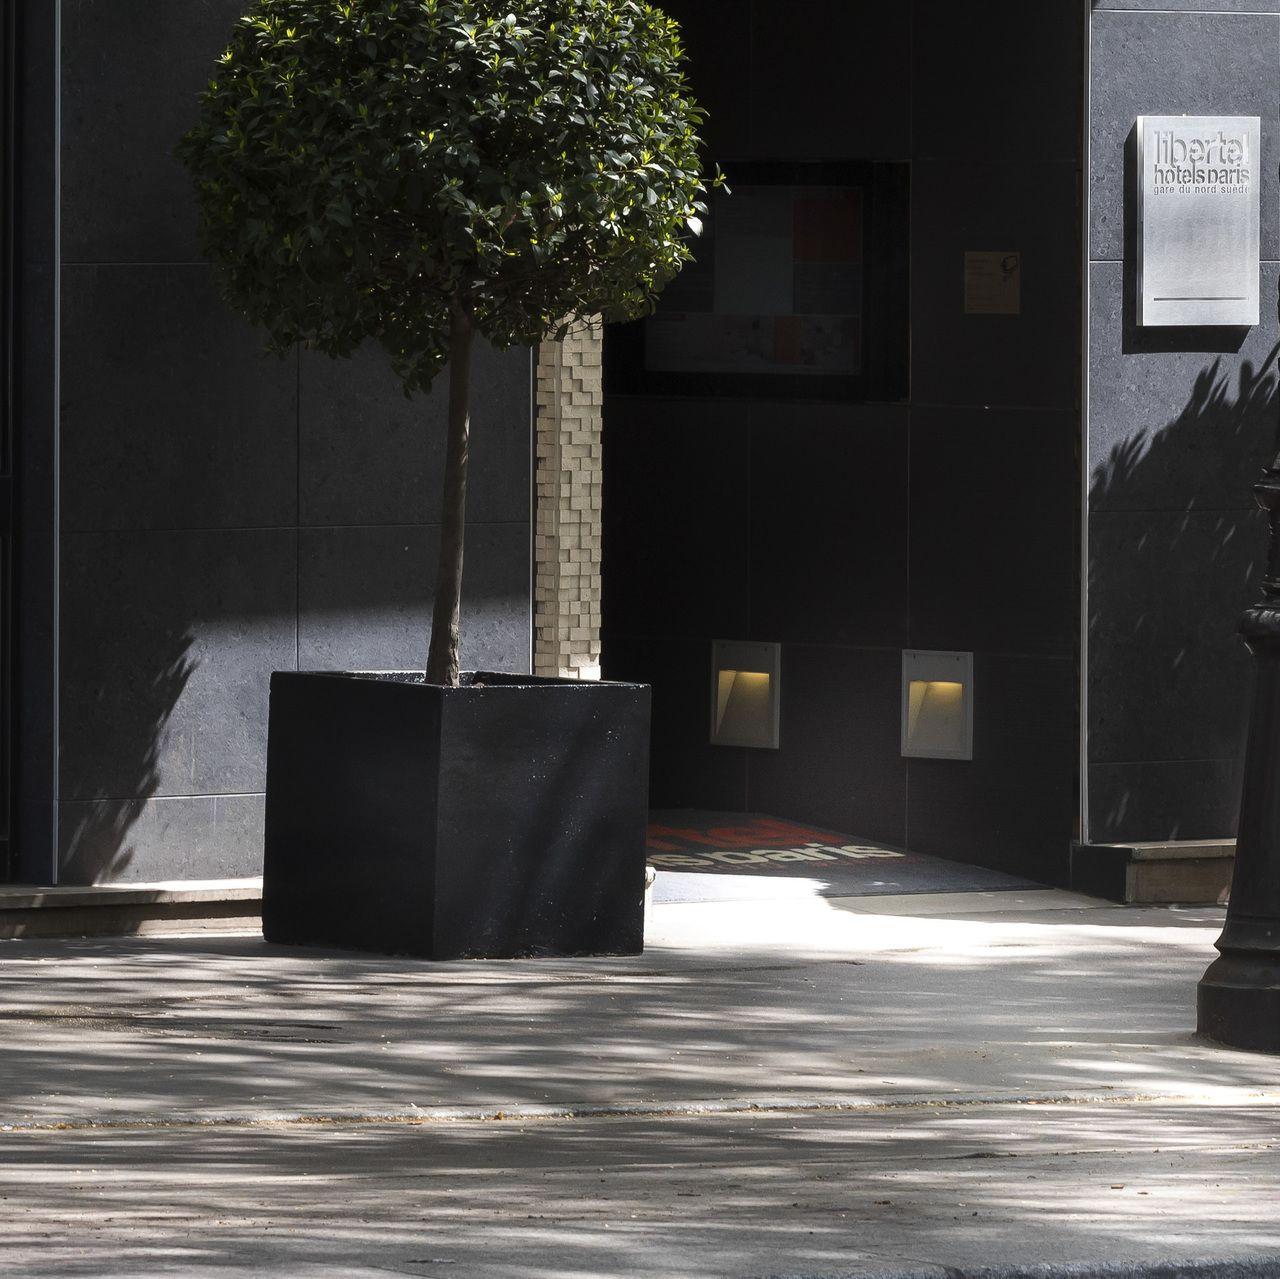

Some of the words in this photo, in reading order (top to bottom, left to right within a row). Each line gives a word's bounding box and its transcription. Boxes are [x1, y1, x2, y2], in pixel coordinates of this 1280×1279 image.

[1153, 130, 1250, 165] libertel
[1207, 163, 1250, 184] paris
[1153, 186, 1175, 196] gare
[1179, 184, 1191, 194] du
[1194, 184, 1217, 194] nord
